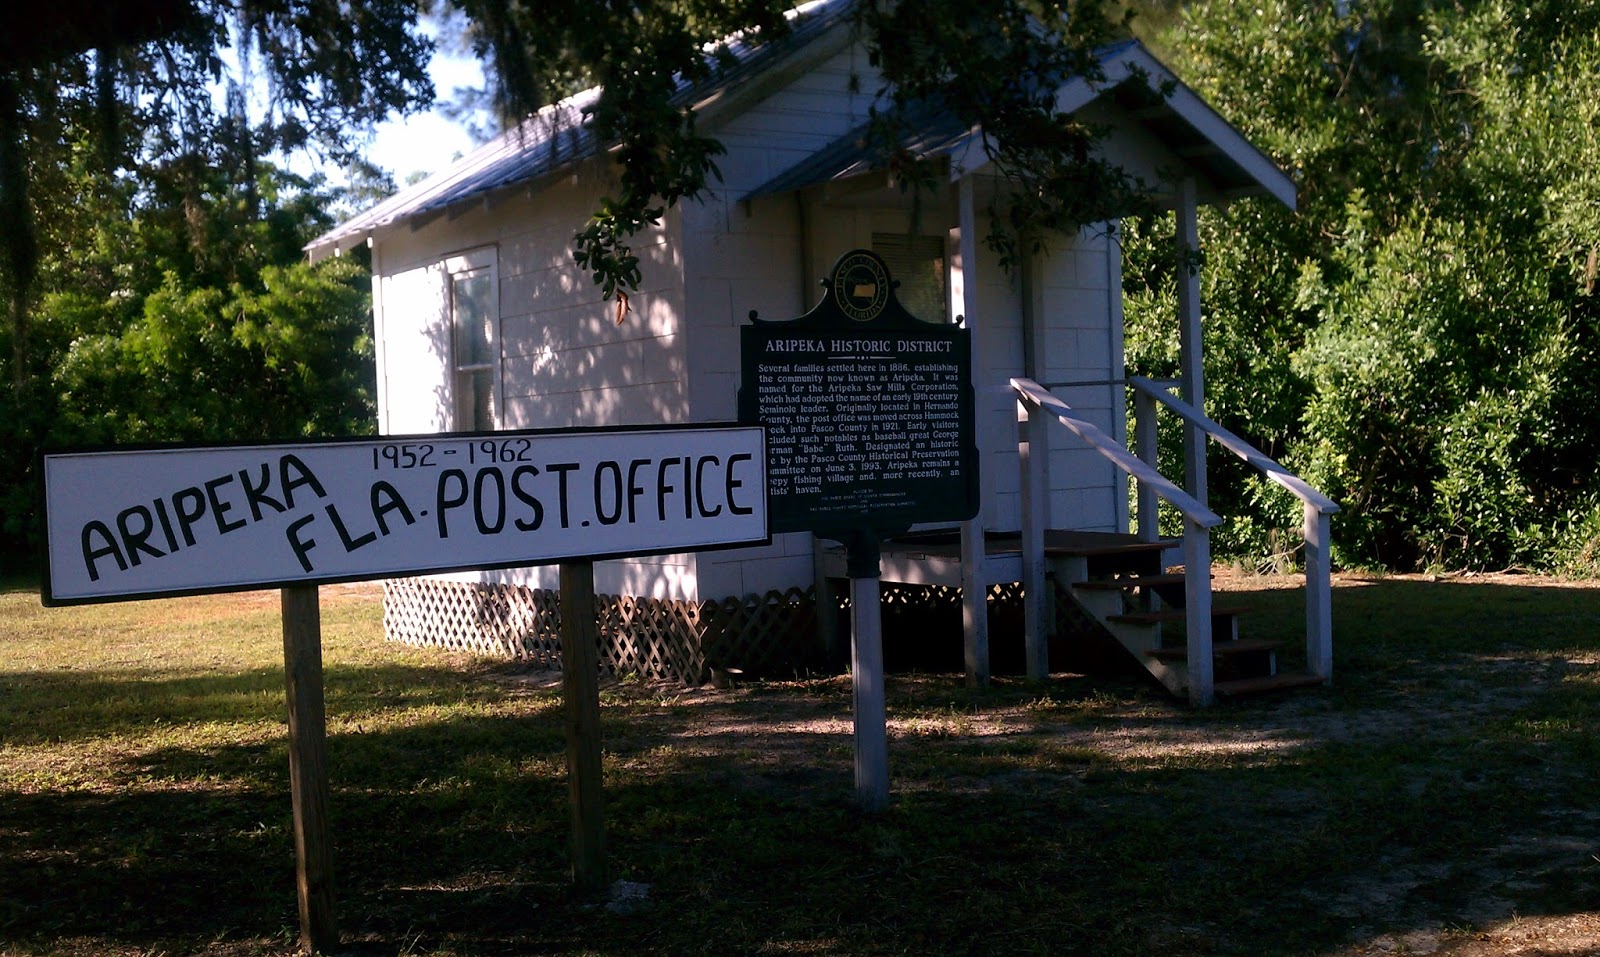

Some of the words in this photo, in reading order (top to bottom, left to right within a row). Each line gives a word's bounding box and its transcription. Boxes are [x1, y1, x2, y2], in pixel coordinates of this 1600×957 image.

[766, 340, 825, 351] ARIPEKA
[832, 340, 890, 351] HISTORIC
[898, 341, 952, 352] DISTRICT
[759, 364, 789, 372] Several
[794, 364, 824, 372] families
[915, 364, 958, 373] establishing
[778, 375, 823, 383] community
[759, 385, 786, 393] named
[792, 384, 804, 392] for
[809, 384, 822, 392] the
[829, 384, 861, 393] Aripeka
[888, 383, 905, 391] Mills
[759, 395, 783, 403] which
[785, 395, 800, 403] had
[802, 394, 834, 404] adopted
[873, 393, 880, 401] of
[893, 393, 911, 402] early
[759, 405, 796, 413] Seminole
[836, 404, 876, 413] Originally
[925, 402, 958, 410] Hernando
[813, 415, 829, 424] post
[833, 413, 855, 421] office
[872, 413, 897, 421] moved
[791, 425, 806, 433] into
[839, 424, 867, 432] County
[907, 422, 926, 430] Early
[801, 435, 819, 443] such
[825, 434, 857, 442] notables
[875, 432, 906, 440] baseball
[909, 432, 929, 441] great
[933, 431, 958, 439] George
[799, 443, 828, 453] "Babe"
[866, 442, 910, 453] Designated
[781, 457, 791, 465] by
[812, 455, 835, 463] Pasco
[838, 454, 866, 462] County
[869, 450, 908, 458] Historical
[912, 450, 959, 458] Preservation
[887, 461, 917, 470] Aripeka
[923, 459, 950, 467] remains
[794, 476, 821, 485] fishing
[827, 471, 853, 481] village
[594, 453, 753, 526] OFFICE
[771, 485, 789, 495] tists'
[796, 483, 821, 493] haven.
[81, 454, 328, 582] ARIPEKA
